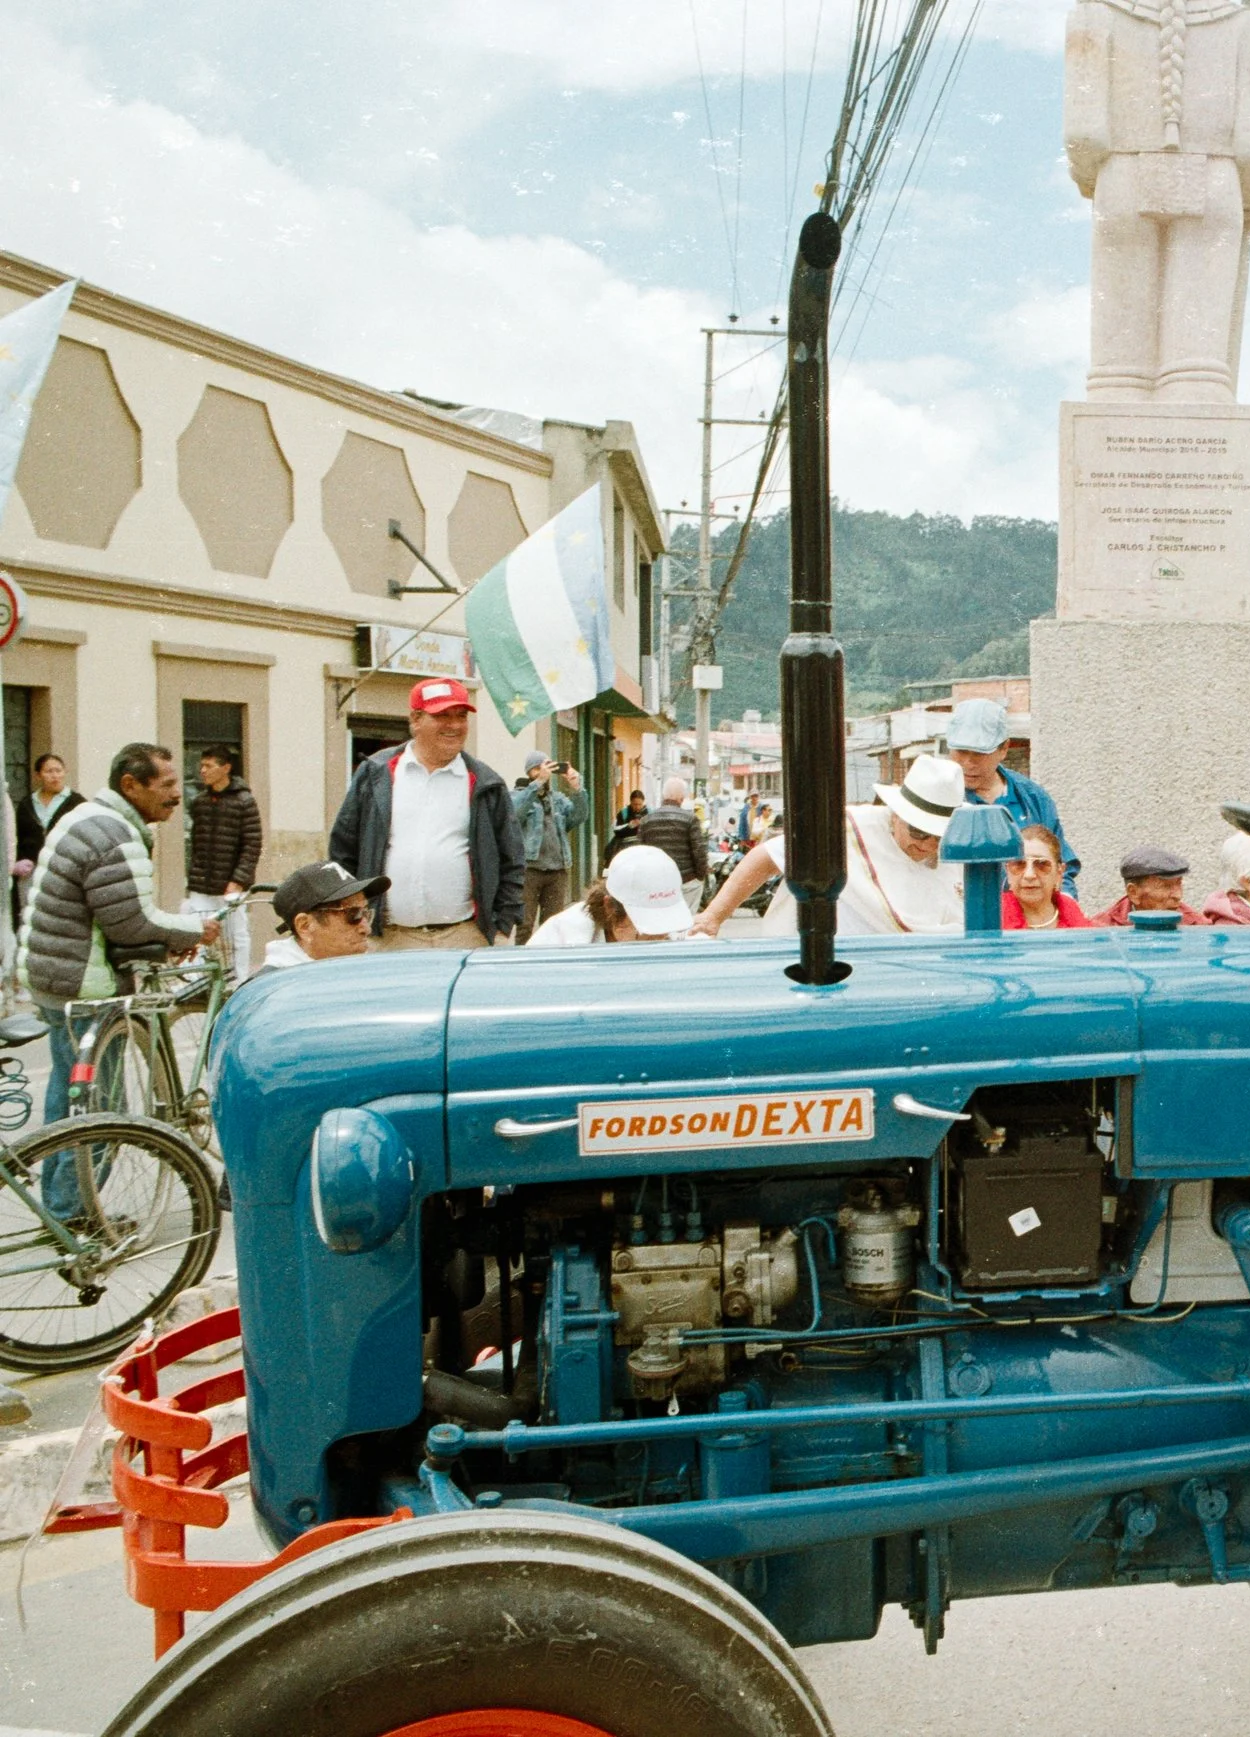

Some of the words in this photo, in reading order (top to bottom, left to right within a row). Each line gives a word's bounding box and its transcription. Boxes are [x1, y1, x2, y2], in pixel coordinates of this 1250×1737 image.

[1117, 472, 1163, 480] FERNANDO
[1107, 543, 1144, 551] CARLOS
[1157, 544, 1217, 552] CRISTANCHO
[588, 1110, 731, 1139] FORDSON
[732, 1096, 864, 1138] DEXTA
[851, 1247, 884, 1257] BOSCH
